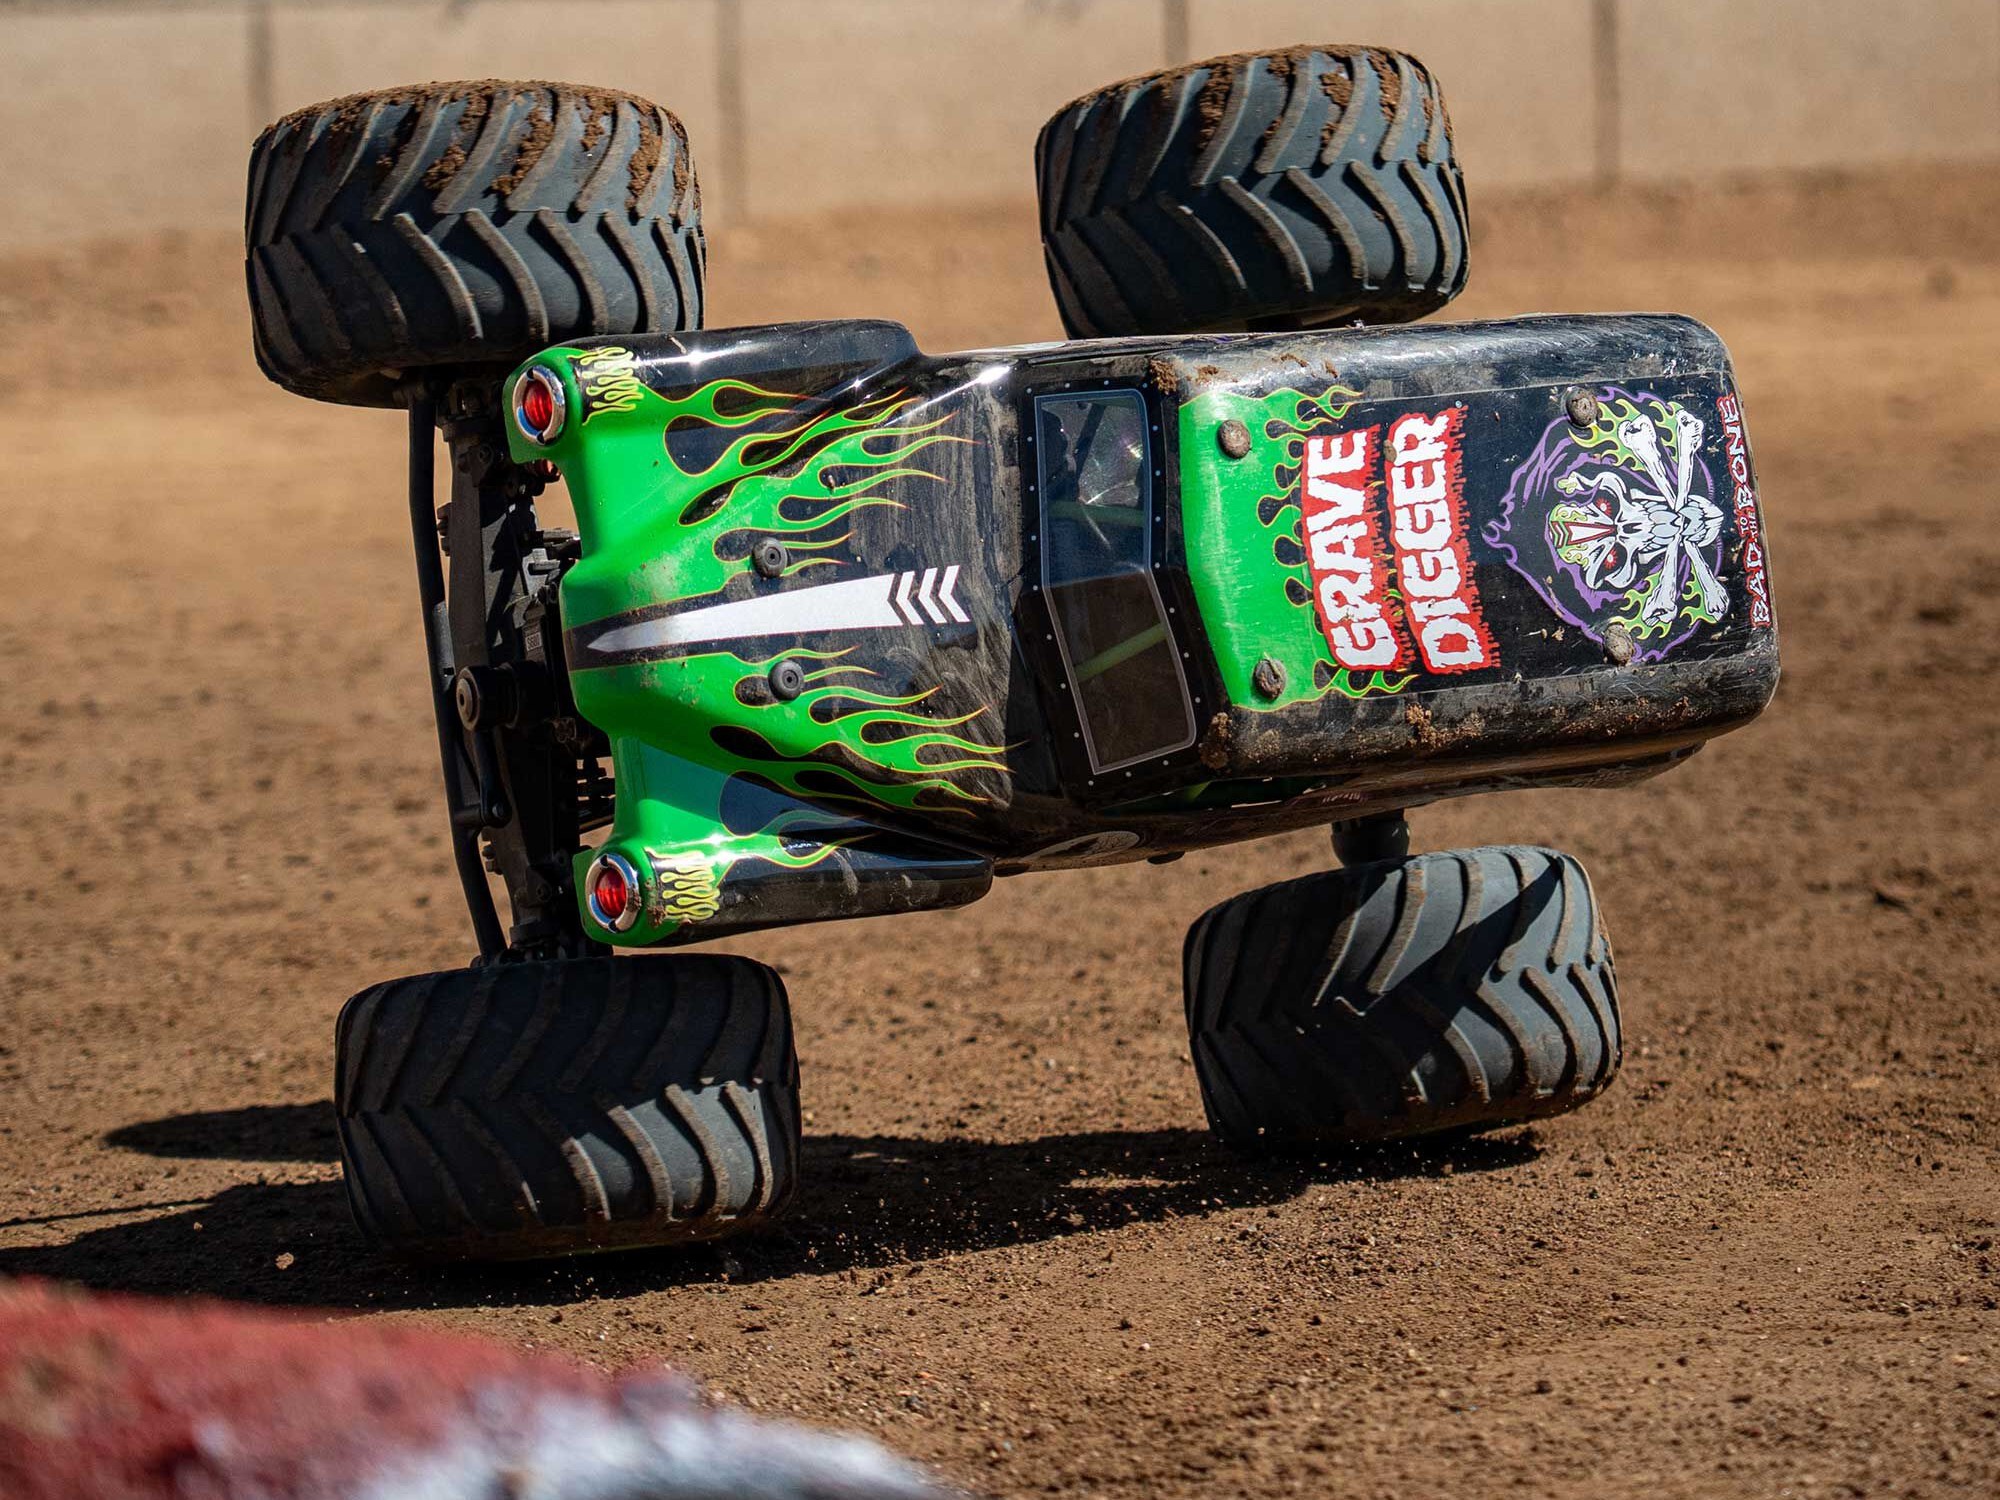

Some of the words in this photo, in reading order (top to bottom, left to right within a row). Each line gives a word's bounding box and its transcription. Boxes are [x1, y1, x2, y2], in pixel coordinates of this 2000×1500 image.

[1720, 396, 1754, 509] BONE
[1306, 431, 1399, 666] GRAVE
[1390, 414, 1485, 668] DIGGER
[1739, 516, 1749, 534] TO
[1749, 511, 1758, 539] THE
[1746, 542, 1770, 623] BAD
